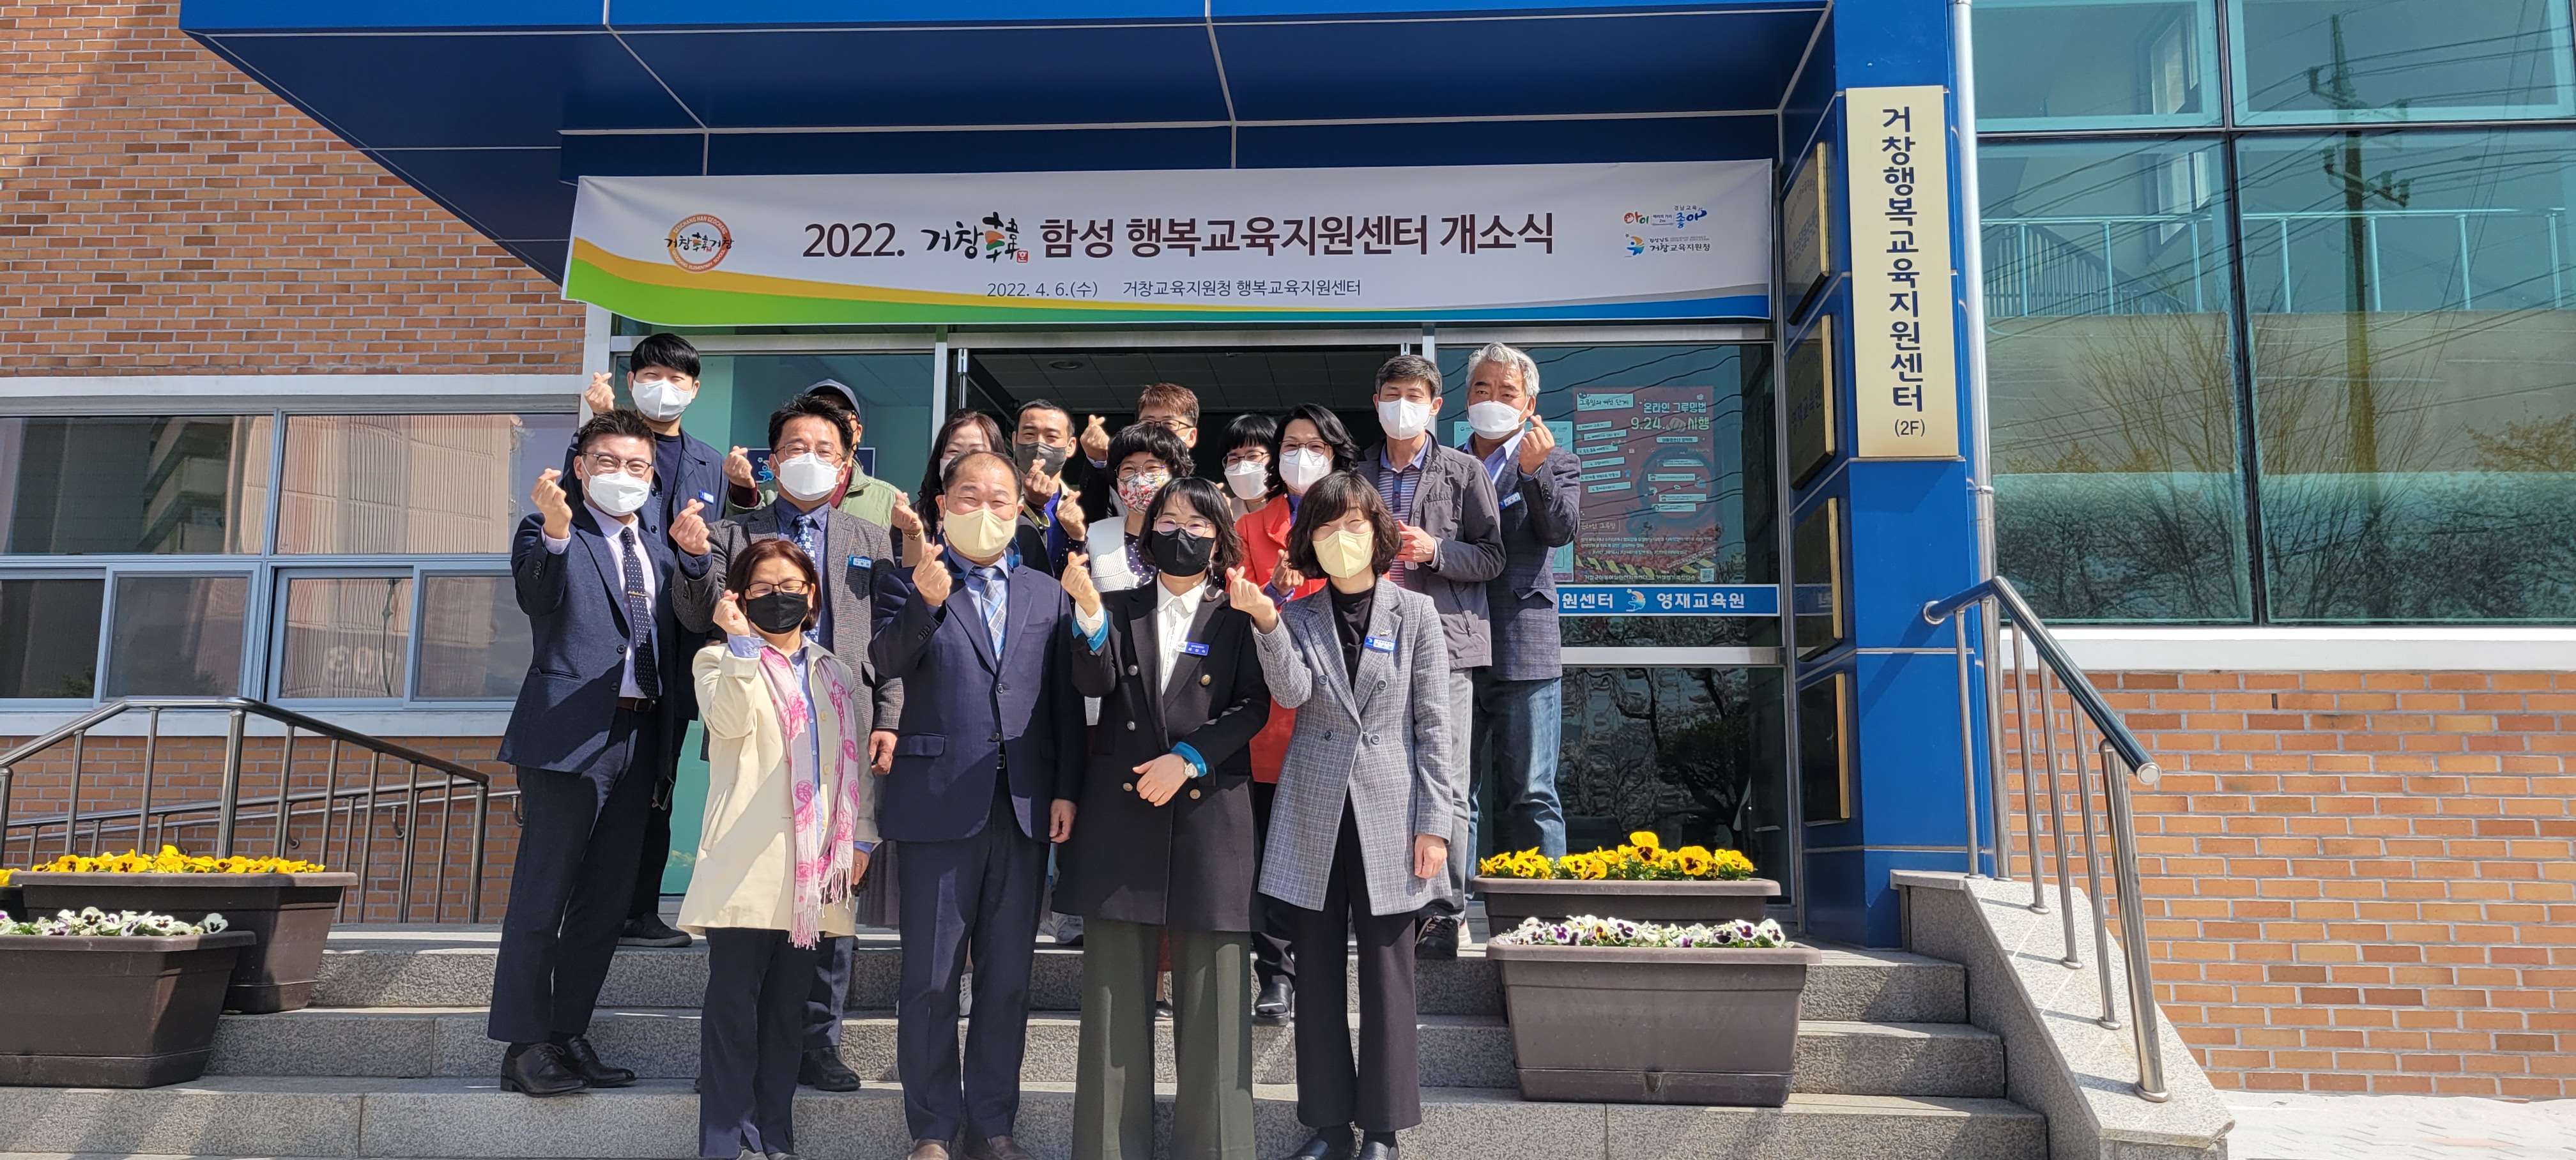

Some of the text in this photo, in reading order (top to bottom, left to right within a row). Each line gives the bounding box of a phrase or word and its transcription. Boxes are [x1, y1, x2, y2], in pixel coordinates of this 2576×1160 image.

[1623, 211, 1708, 229] 아이 좋아
[802, 222, 905, 257] 2022.
[1039, 218, 1114, 258] 함성
[1126, 215, 1427, 258] 행복교육지원센터
[1439, 212, 1552, 255] 개소식
[1649, 243, 1710, 253] 거창교육지원청
[1882, 107, 1924, 412] 거창행복교육지원센터
[987, 279, 1360, 298] 2022. 4. 6.(수) 거창교육지원청 행복교육지원센터
[1643, 402, 1706, 414] 온라인 그루밍법
[1630, 416, 1710, 431] 9.24. 시행
[1894, 419, 1925, 438] (2F)
[1656, 591, 1745, 609] 영재교육원
